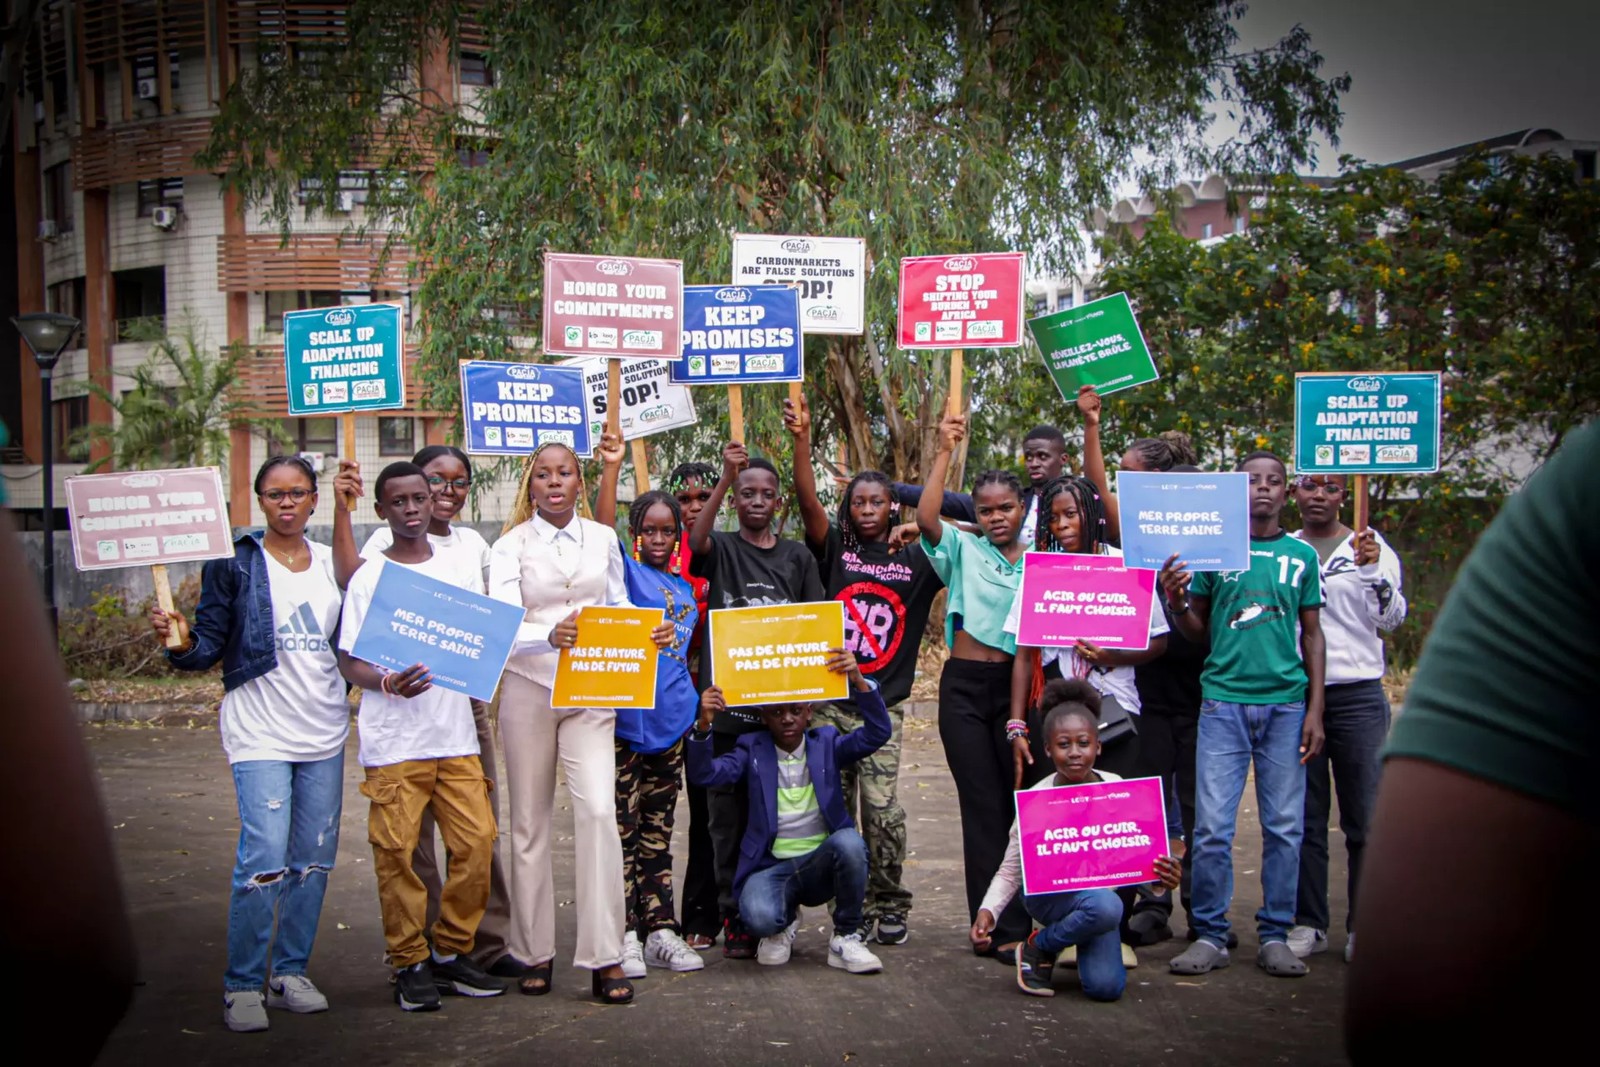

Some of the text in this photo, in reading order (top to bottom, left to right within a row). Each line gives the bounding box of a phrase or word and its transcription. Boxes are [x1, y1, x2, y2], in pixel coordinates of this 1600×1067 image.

[786, 242, 810, 250] PACJA
[756, 257, 841, 267] CARBONMARKETS
[742, 266, 855, 277] ARE FALSE SOLUTIONS
[936, 273, 985, 291] STOP
[563, 281, 667, 300] HONOR YOUR
[720, 291, 747, 300] PACJA
[972, 290, 997, 300] YOUR
[554, 300, 674, 320] COMMITMENTS
[974, 300, 988, 309] TO
[704, 306, 765, 326] KEEP
[941, 310, 977, 320] AFRICA
[309, 327, 375, 346] SCALE UP
[629, 335, 656, 343] PACJA
[682, 327, 795, 350] PROMISES
[302, 343, 384, 363] ADAPTATION
[1098, 342, 1132, 358] BRÛLE
[310, 361, 379, 380] FINANCING
[624, 366, 668, 384] SOLUTION
[497, 381, 554, 402] KEEP
[1353, 380, 1380, 389] PACJA
[592, 381, 660, 414] SOP!
[1327, 394, 1408, 409] SCALE UP
[472, 402, 582, 425] PROMISES
[644, 408, 669, 419] PACJA
[1316, 411, 1418, 426] ADAPTATION
[1325, 427, 1411, 442] FINANCING
[1138, 510, 1163, 521] MER
[1139, 524, 1223, 536] TERRE SAINE
[1277, 555, 1305, 588] 17
[1043, 590, 1075, 602] AGIR
[1034, 602, 1047, 613] IL
[1049, 603, 1083, 615] FAUT
[394, 607, 424, 627] MER
[390, 621, 480, 660] TERRE SAINE
[569, 647, 587, 658] PAS
[588, 647, 602, 657] DE
[728, 647, 753, 659] PAS
[755, 645, 774, 656] DE
[571, 661, 640, 673] PAS DE FUTUR
[735, 659, 761, 671] PAS
[762, 658, 781, 669] DE
[1044, 827, 1079, 841] AGIR
[1103, 821, 1142, 835] CUIR,
[1036, 845, 1051, 856] IL
[1053, 841, 1090, 854] FAUT
